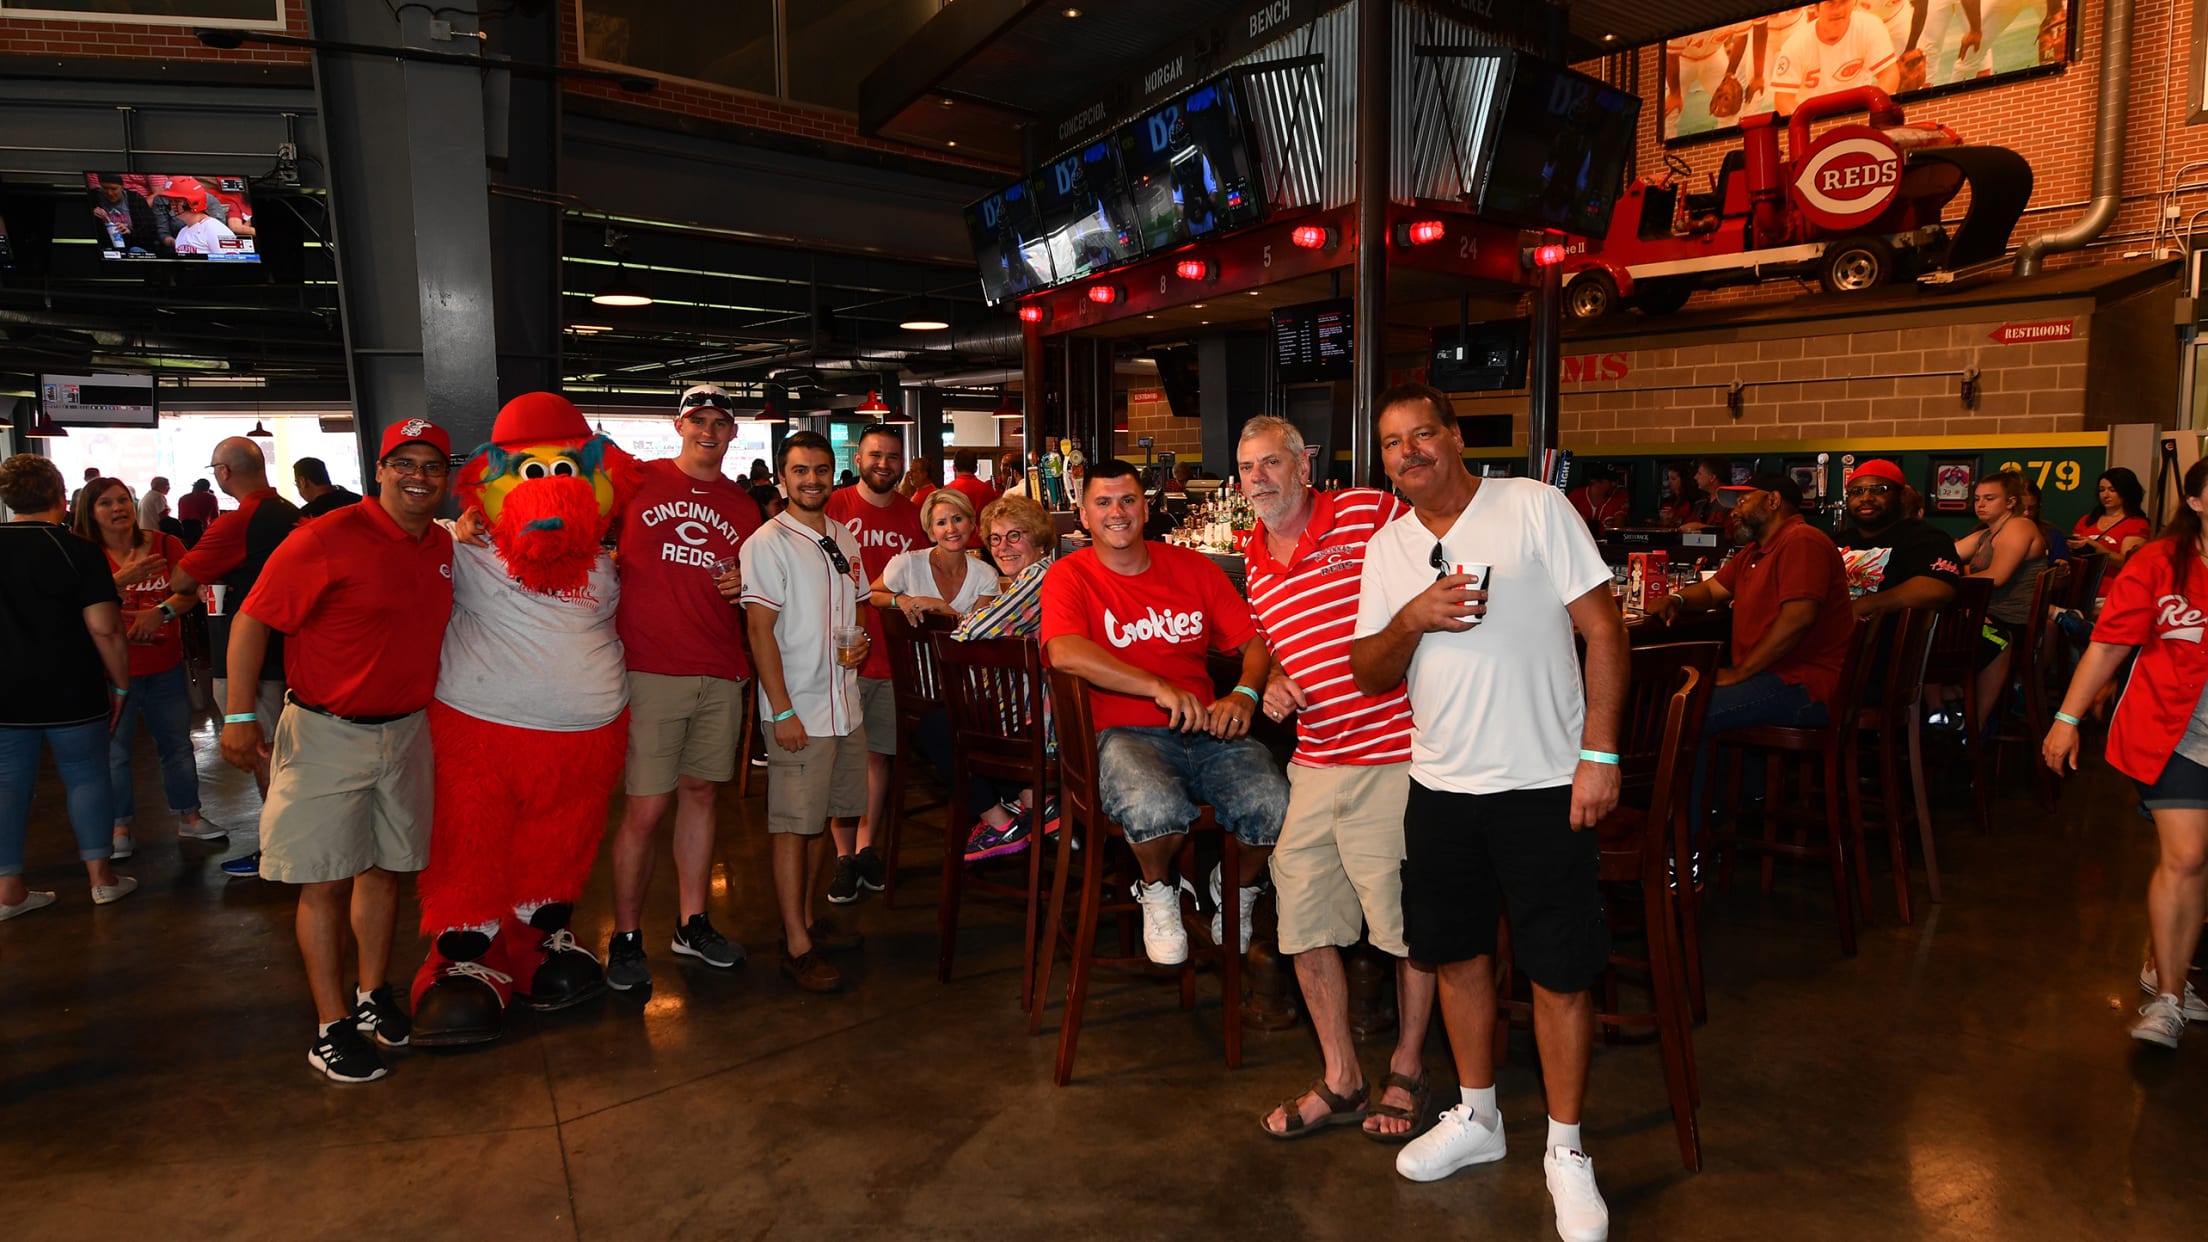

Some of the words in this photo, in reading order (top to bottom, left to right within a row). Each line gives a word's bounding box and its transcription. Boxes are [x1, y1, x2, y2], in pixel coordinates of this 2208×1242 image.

[1249, 0, 1291, 39] BENCH
[1144, 56, 1183, 95] MORGAN
[1804, 68, 1820, 89] 5
[1822, 160, 1897, 192] REDS
[1263, 245, 1273, 268] 5
[1460, 235, 1479, 260] 24
[1160, 274, 1168, 295] 8
[2004, 323, 2071, 340] RESTROOMS
[1561, 351, 1629, 385] MS
[1559, 460, 1571, 488] LIGHT
[641, 500, 740, 547] CINCINNATI
[661, 542, 716, 570] REDS
[2156, 593, 2208, 628] Re
[1103, 605, 1204, 649] Cookies
